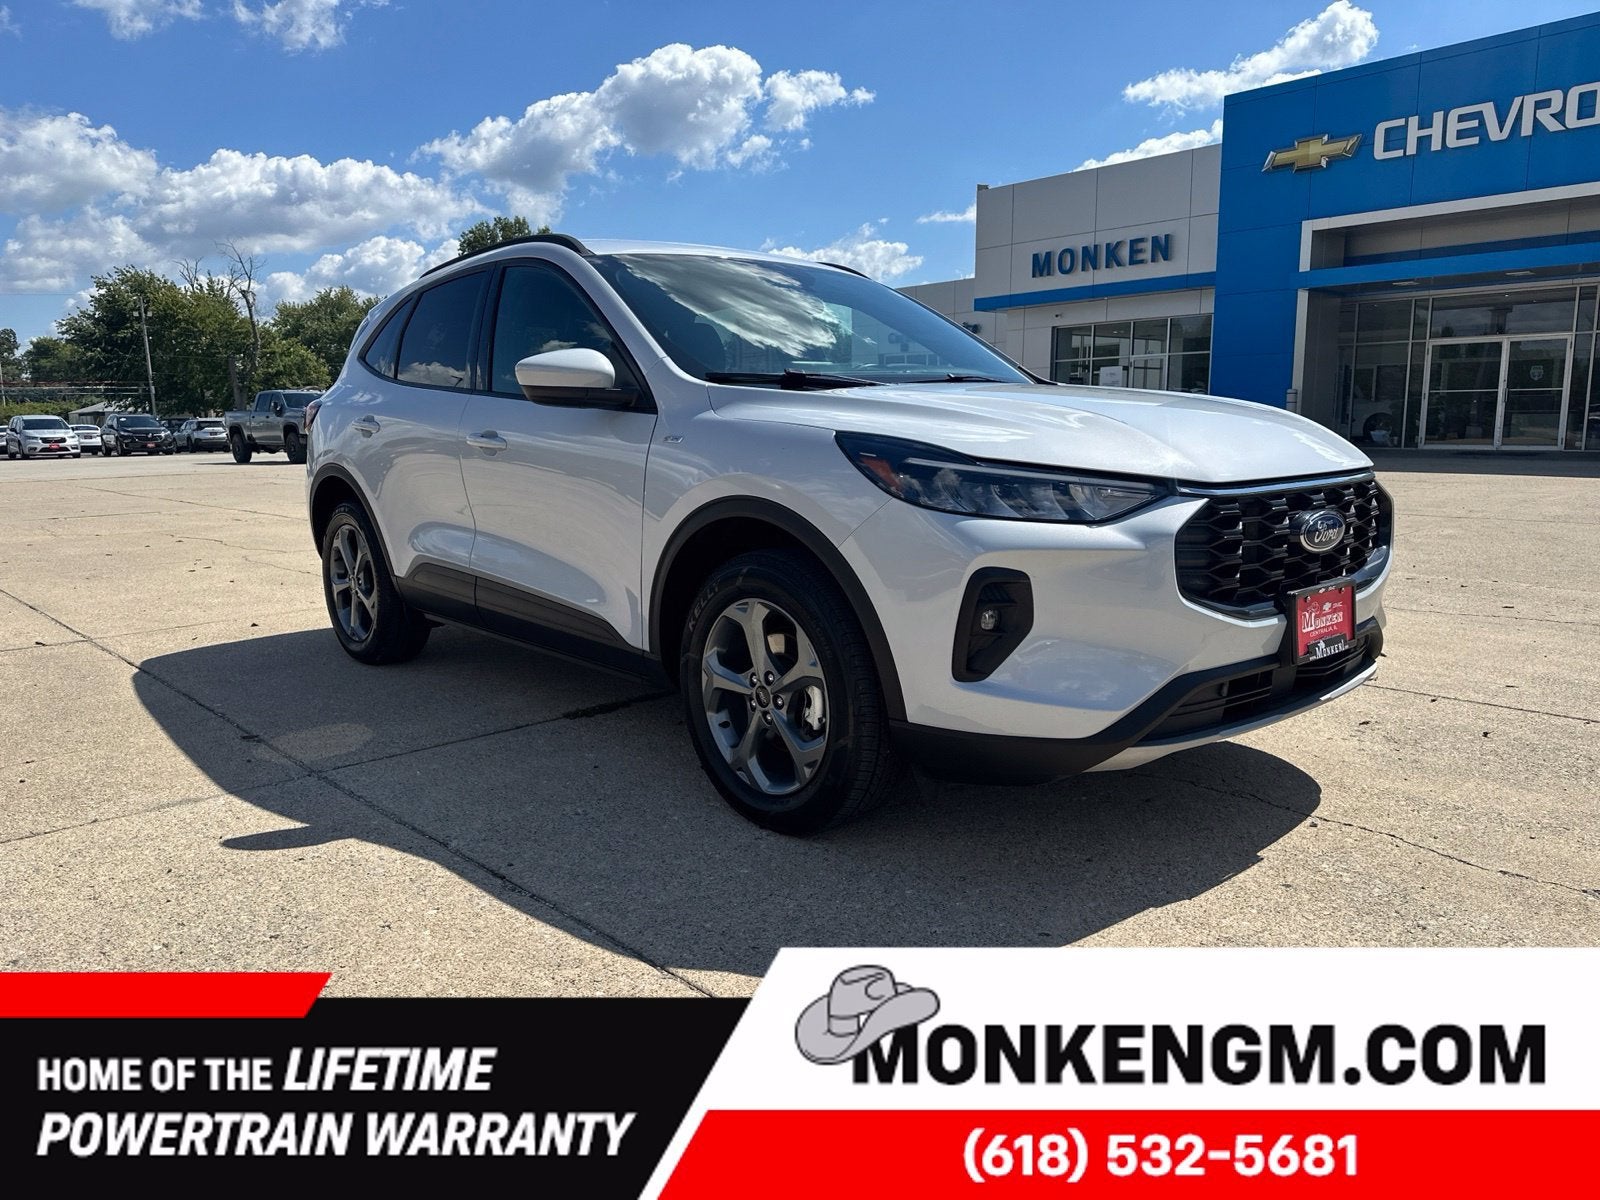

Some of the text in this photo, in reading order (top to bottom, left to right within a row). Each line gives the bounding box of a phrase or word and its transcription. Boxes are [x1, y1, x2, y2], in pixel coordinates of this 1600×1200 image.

[1031, 233, 1171, 278] MONKEN
[1314, 519, 1339, 543] Ford
[1302, 611, 1343, 633] MONKEN
